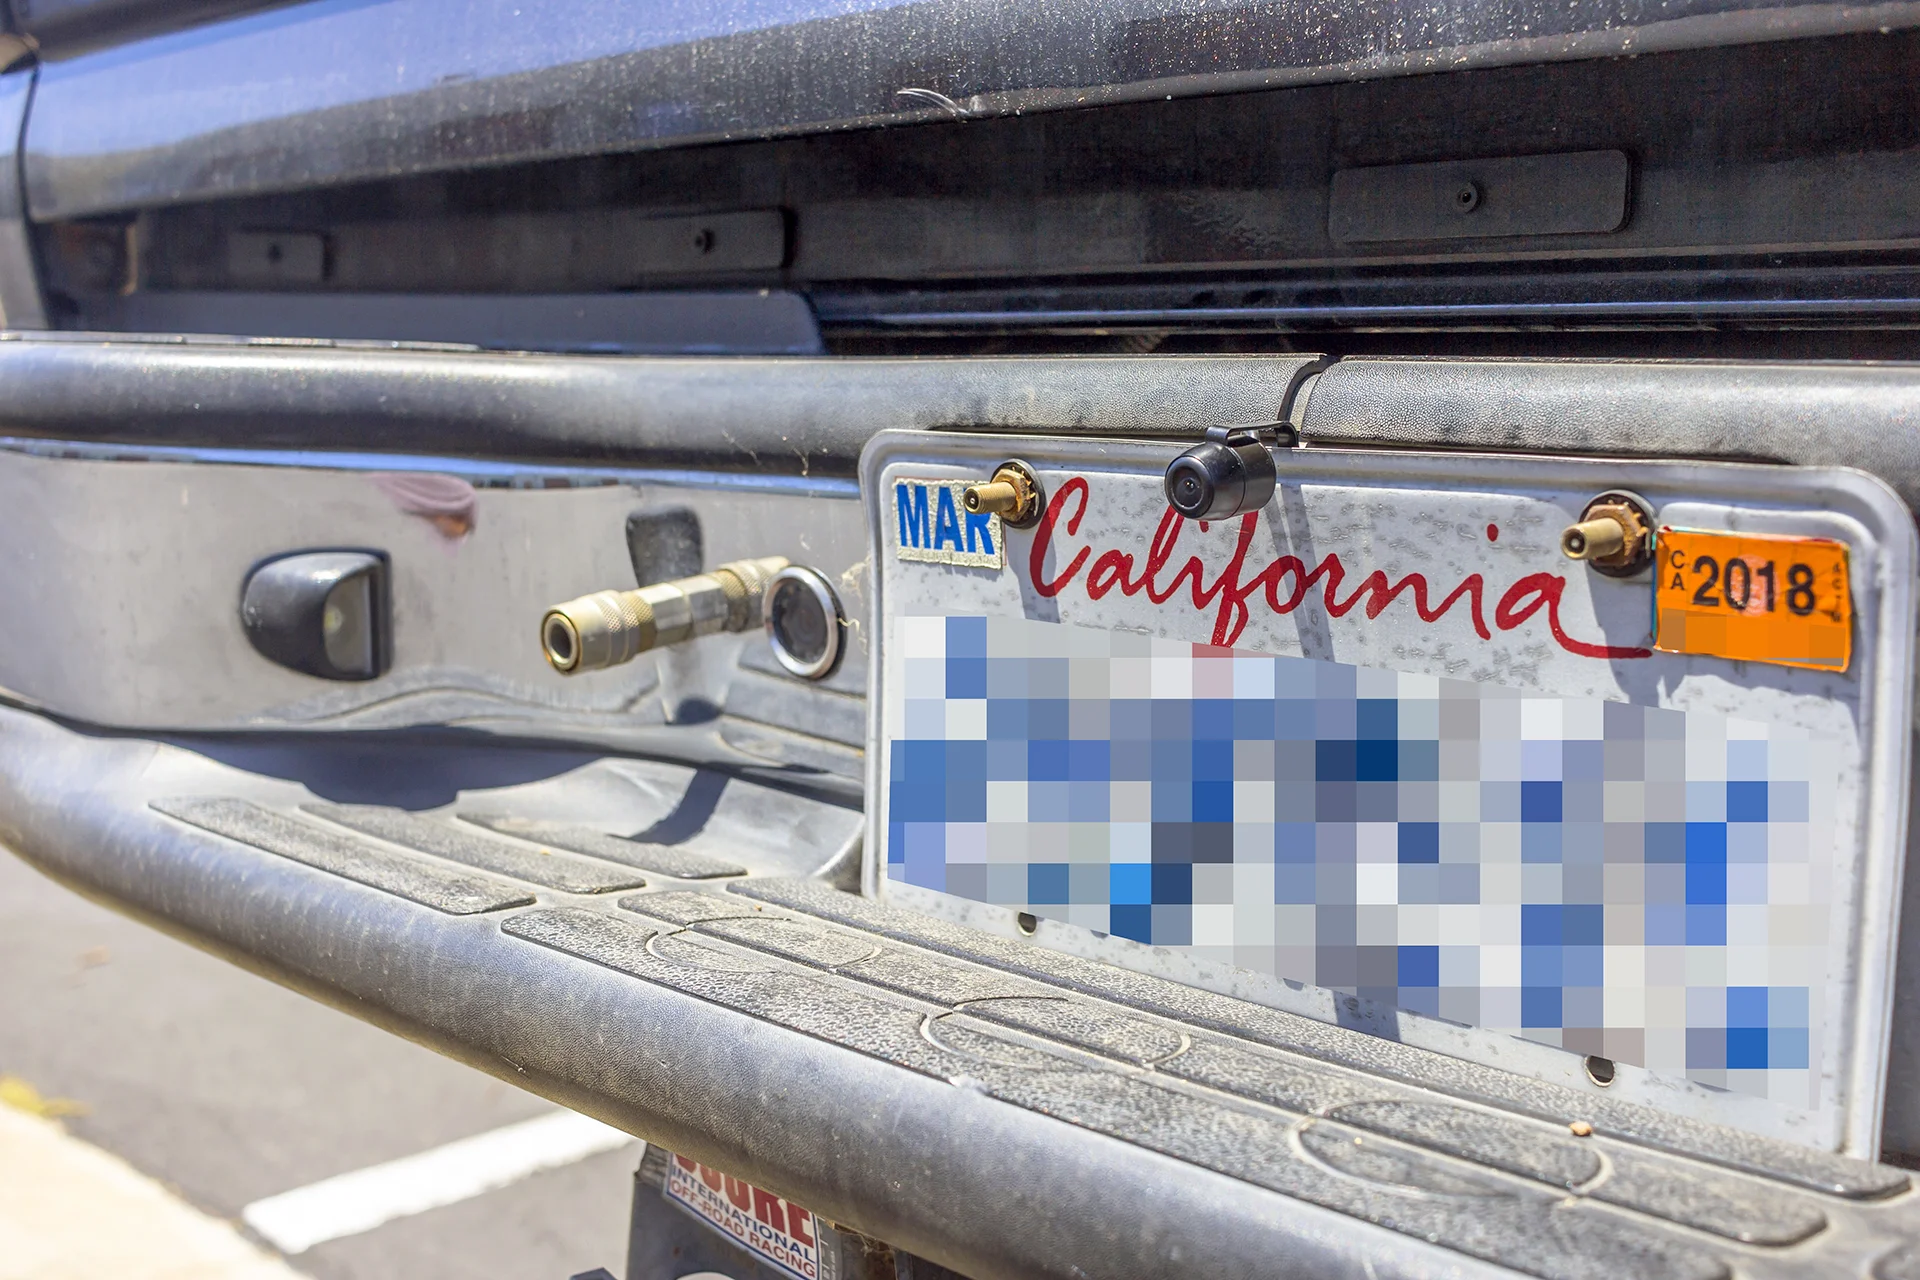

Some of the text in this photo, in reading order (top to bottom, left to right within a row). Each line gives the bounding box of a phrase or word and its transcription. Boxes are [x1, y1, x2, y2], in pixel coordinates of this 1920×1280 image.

[896, 483, 995, 555] MAR
[1029, 476, 1653, 659] California
[1692, 555, 1816, 616] 2018
[671, 1180, 744, 1237] OFF-ROAD
[749, 1230, 816, 1278] RACING
[673, 1165, 816, 1264] INTERNATIONAL
